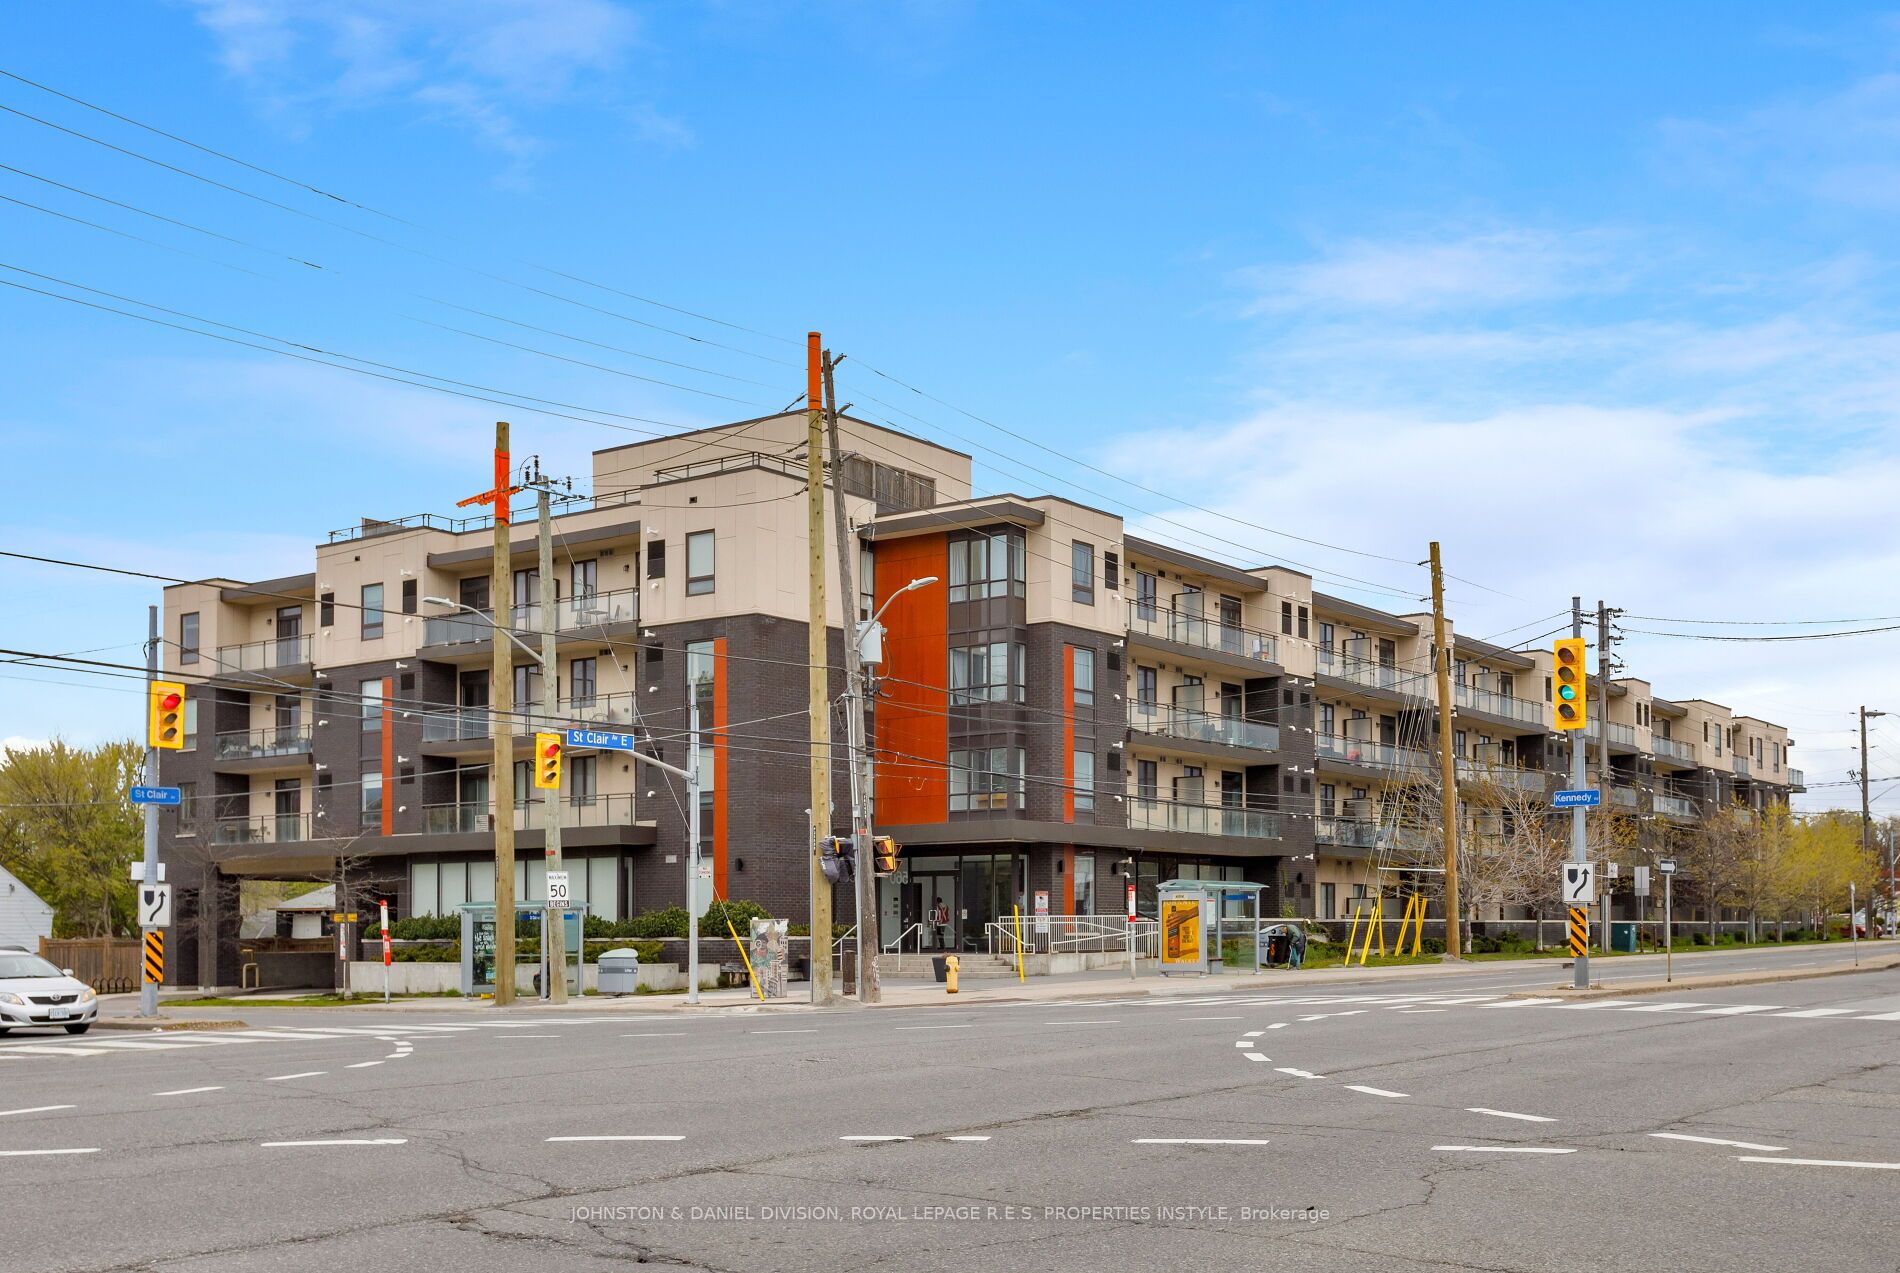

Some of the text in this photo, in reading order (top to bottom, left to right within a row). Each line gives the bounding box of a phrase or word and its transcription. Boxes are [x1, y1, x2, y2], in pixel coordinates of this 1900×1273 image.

[573, 730, 584, 743] St
[587, 732, 609, 745] Clair
[621, 735, 628, 746] E
[135, 789, 145, 799] St
[146, 789, 168, 799] Clair
[1555, 792, 1592, 803] Kennedy
[550, 884, 567, 898] 50
